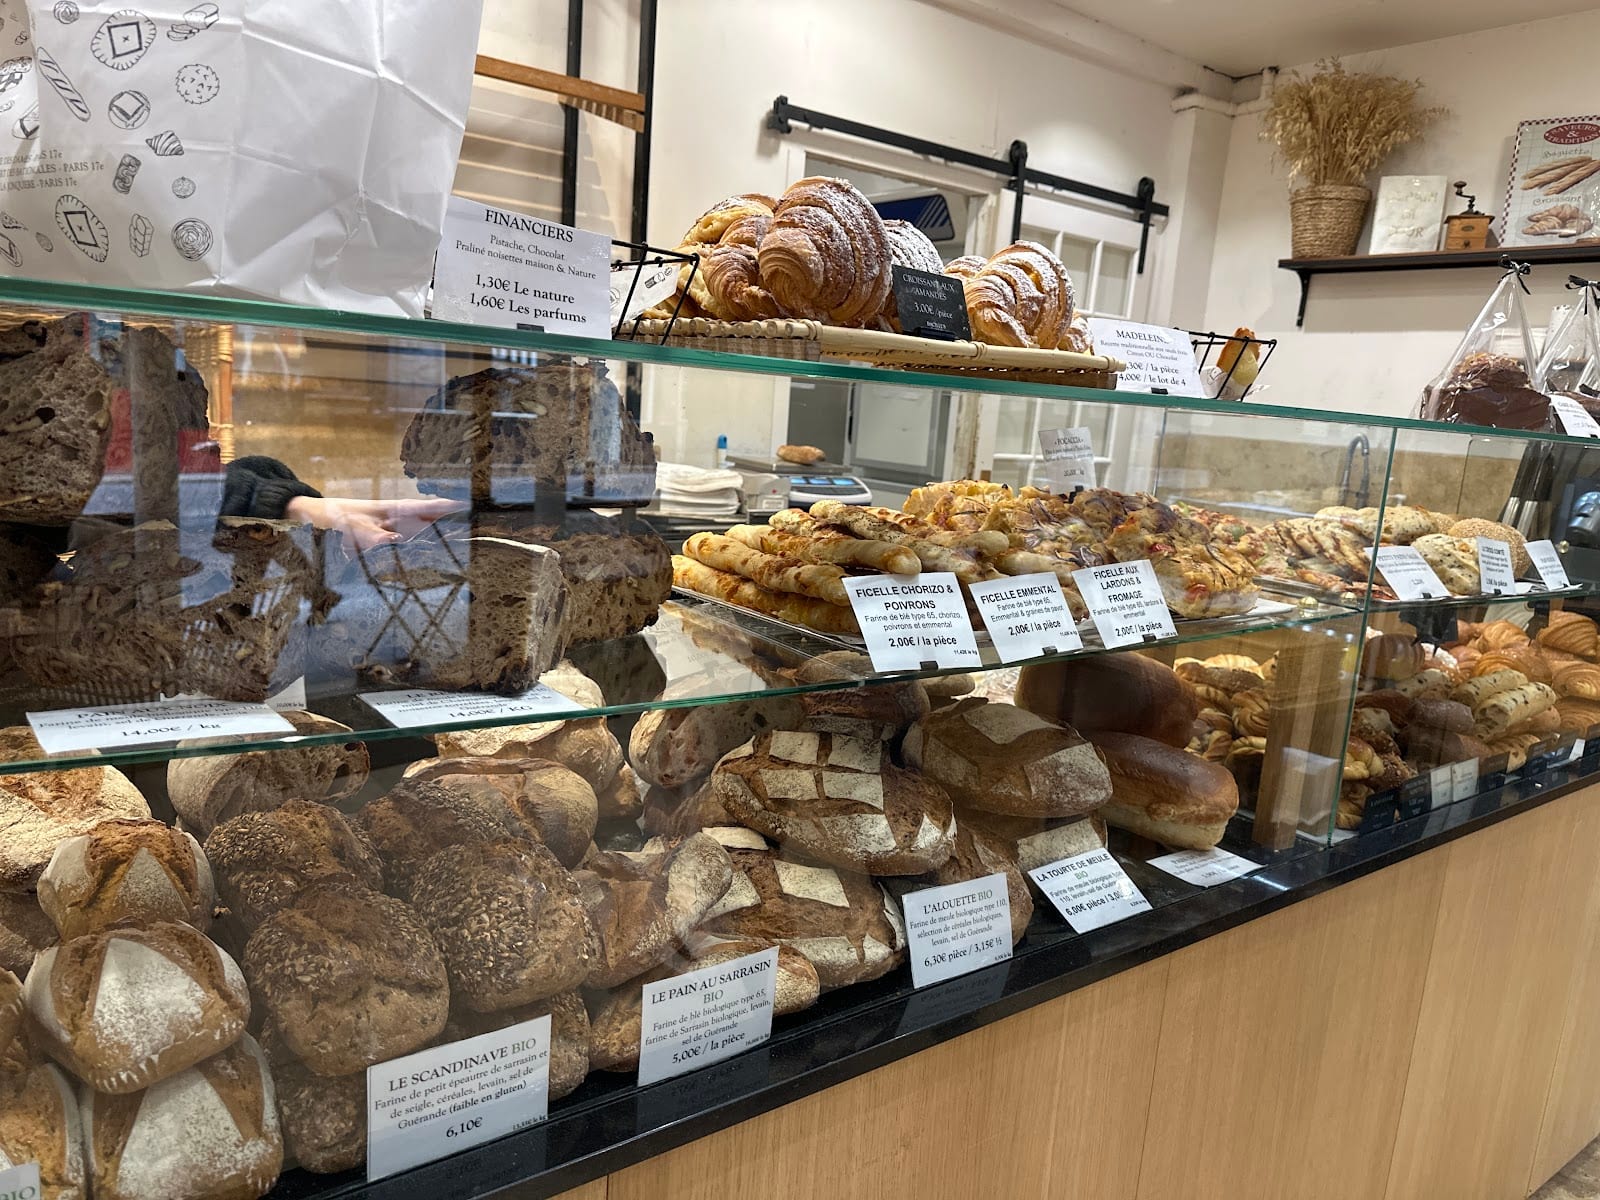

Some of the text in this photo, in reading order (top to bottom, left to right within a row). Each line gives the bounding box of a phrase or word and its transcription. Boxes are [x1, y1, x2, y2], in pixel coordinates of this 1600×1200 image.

[1550, 124, 1597, 134] SAVEURS
[1548, 132, 1599, 144] TRADITION
[64, 162, 89, 172] PARIS
[484, 209, 574, 242] FINANCIERS
[490, 234, 525, 252] Pistache,
[456, 240, 596, 280] Praliné noisettes maison & Nature
[475, 274, 575, 304] 1,30€ Le nature
[470, 293, 587, 324] 1,60€ Les parfums
[1126, 362, 1180, 374] ,30€ pièce
[1118, 374, 1141, 382] 4,00€
[1158, 376, 1168, 384] lot
[1170, 376, 1180, 385] de
[1094, 566, 1138, 580] FICELLE AUX
[856, 584, 954, 598] FICELLE CHORIZO &
[1100, 578, 1134, 590] LARDONS
[980, 585, 1057, 604] FICELLE EMMENTAL
[1108, 590, 1143, 603] FROMAGE
[884, 600, 936, 610] POIVRONS
[996, 598, 1043, 610] Farine de type
[1093, 601, 1157, 616] Farine type lardons
[864, 614, 888, 622] Farine
[911, 612, 925, 621] type
[926, 612, 938, 620] 65,
[939, 612, 963, 620] chorizo,
[990, 606, 1064, 622] Emmental graines pavot
[1123, 611, 1145, 619] emmental
[883, 623, 912, 632] poivrons
[922, 620, 952, 629] emmental
[1008, 620, 1061, 636] 2,00€ la pièce
[1115, 622, 1162, 637] 2,00€ la pièce
[888, 636, 957, 648] 2,00€ la pièce
[78, 710, 125, 718] PAIN
[450, 709, 496, 718] 14,00€
[122, 726, 182, 736] 14,00€
[1036, 854, 1110, 882] LA TOURTE DE MEULE
[1075, 870, 1088, 880] BIO
[924, 889, 993, 914] L'ALOUETTE BIO
[1050, 889, 1067, 898] Farine
[1060, 896, 1072, 904] 110,
[910, 921, 928, 930] Farine
[938, 913, 954, 923] meule
[956, 906, 983, 917] biologique
[984, 903, 995, 913] type
[996, 898, 1007, 907] 110,
[1065, 898, 1106, 916] 6,00€ pièce
[917, 928, 942, 939] sélection
[952, 920, 972, 930] céréales
[972, 912, 1003, 926] biologiques,
[932, 937, 950, 947] levain,
[967, 924, 992, 936] Guérande
[924, 939, 994, 968] 6,30€ pièce 3,15€
[652, 960, 771, 1004] LE PAIN AU SARRASIN
[703, 990, 724, 1004] BIO
[653, 995, 754, 1032] Farine de blé biologique type
[645, 1000, 771, 1046] farine de Sarrasin biologique, levain,
[682, 1021, 738, 1046] sel de Guérande
[672, 1046, 701, 1063] 5,00€
[710, 1041, 719, 1050] la
[722, 1032, 745, 1048] pièce
[389, 1038, 537, 1092] LE SCANDINAVE BIO
[374, 1050, 548, 1111] Farine de petit épeautre de sarrasin et
[390, 1067, 534, 1119] de seigle, céréales, levain, sel de
[398, 1109, 447, 1129] Guérande
[449, 1098, 478, 1114] (faible
[494, 1080, 527, 1100] gluten)
[446, 1117, 483, 1138] 6,10€
